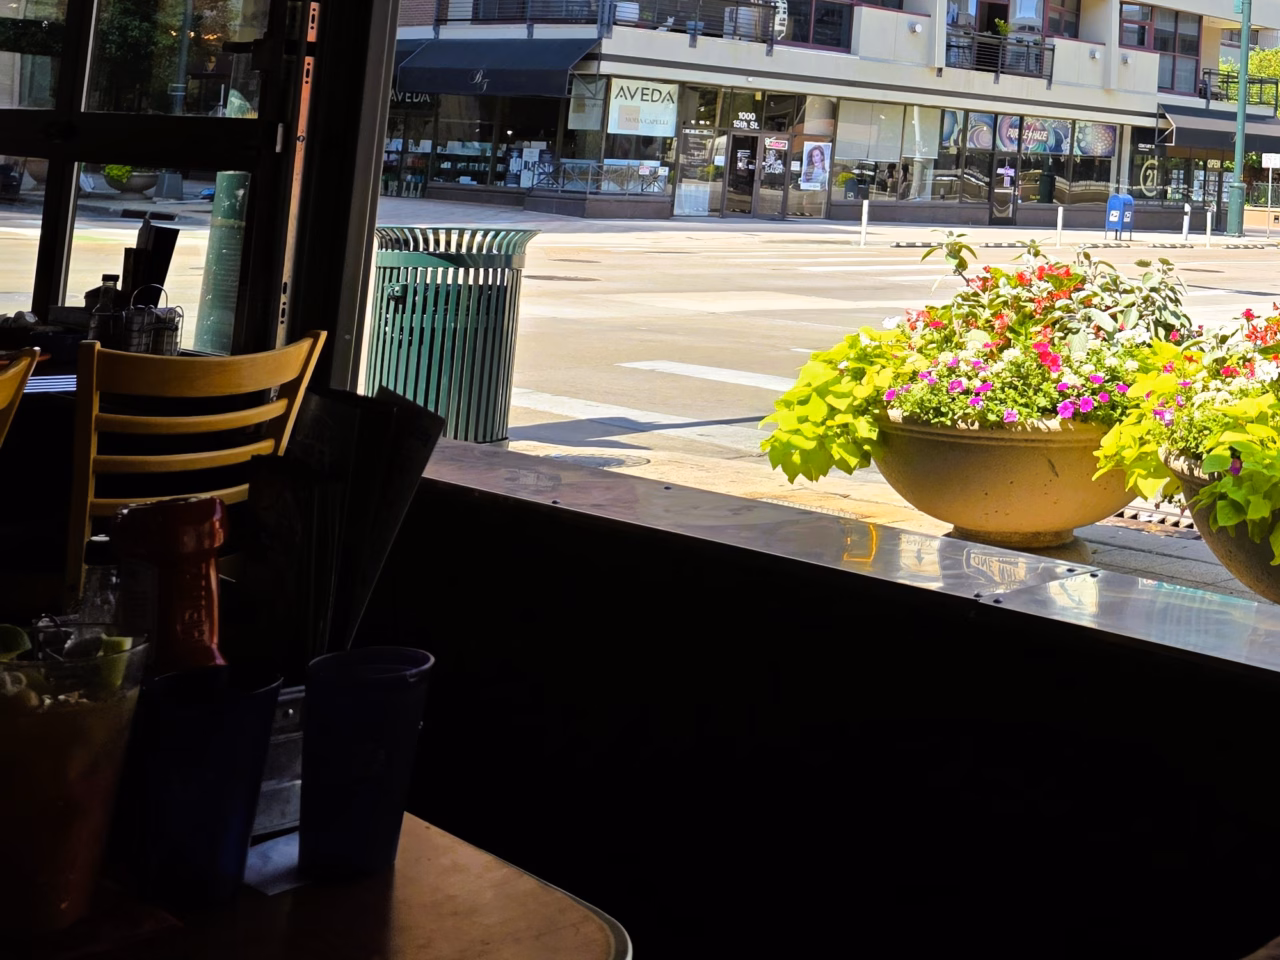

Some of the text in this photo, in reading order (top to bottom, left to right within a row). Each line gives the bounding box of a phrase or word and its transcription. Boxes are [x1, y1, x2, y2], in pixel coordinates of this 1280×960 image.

[389, 89, 430, 103] AVEDA
[614, 85, 675, 104] AVEDA
[738, 112, 756, 121] 1000
[733, 120, 748, 129] 15th
[1007, 128, 1048, 140] PURLE HAZE
[1207, 159, 1221, 169] OPEN
[1146, 170, 1157, 186] 21
